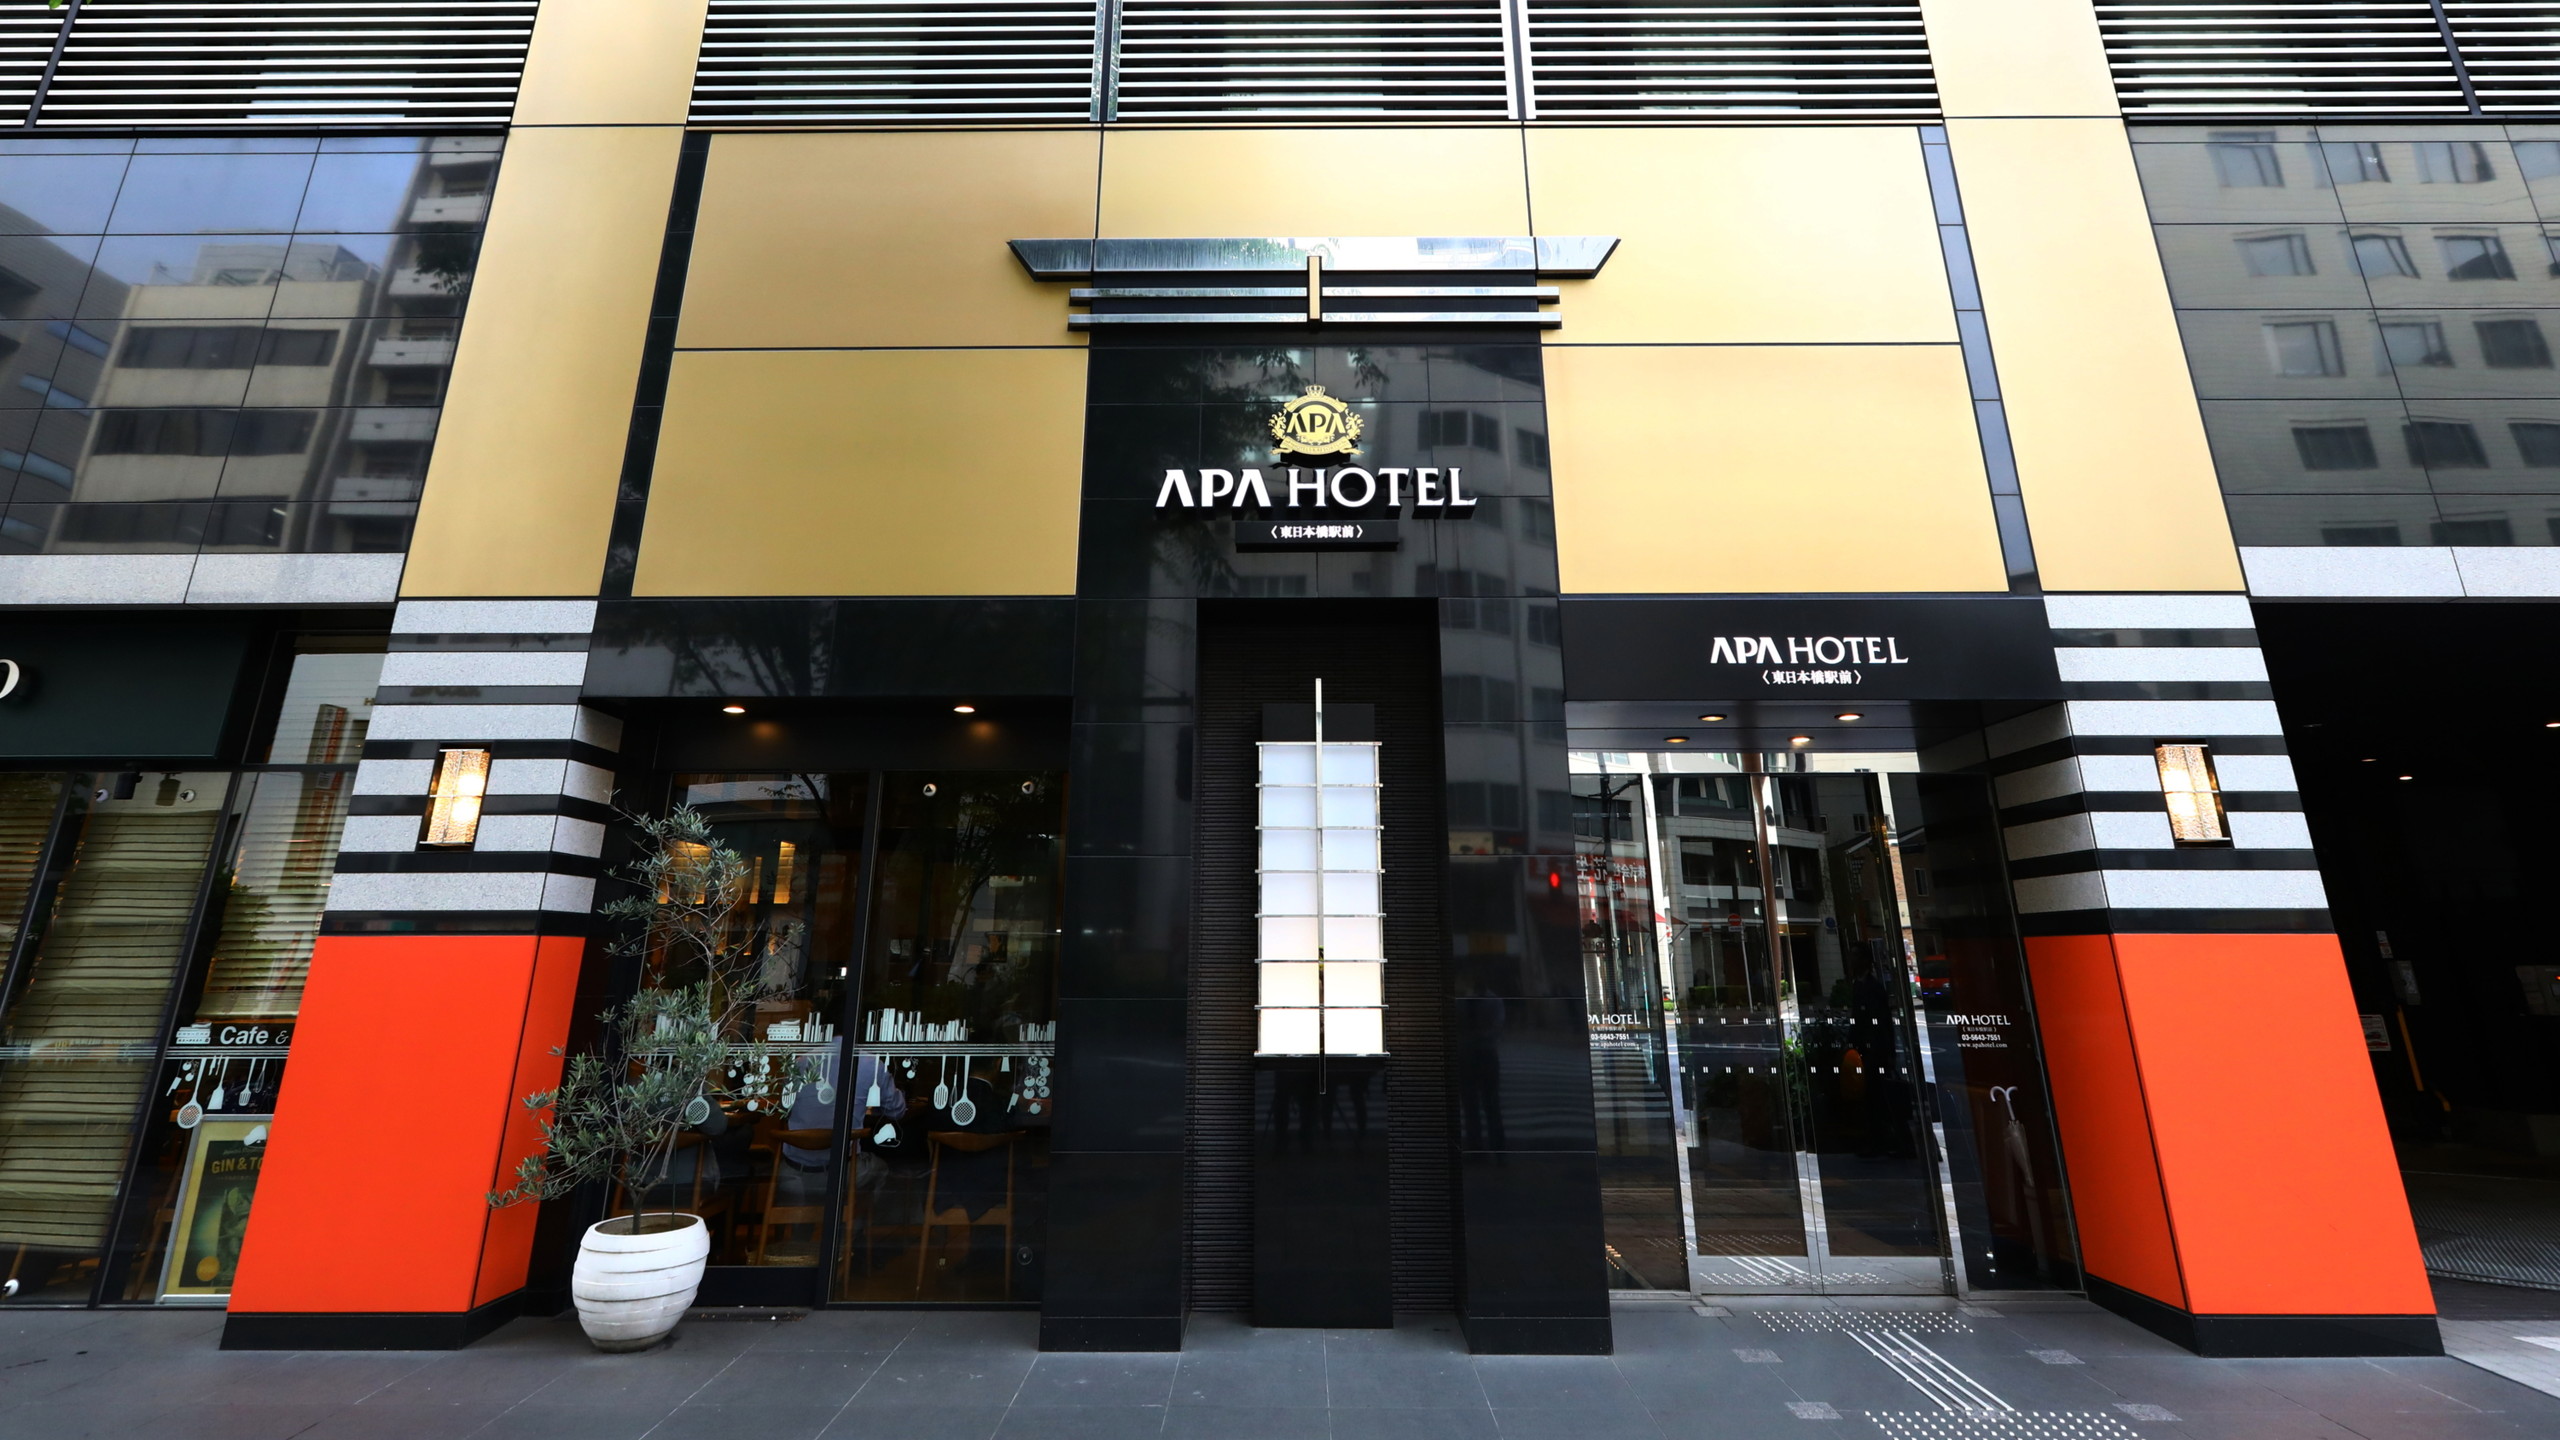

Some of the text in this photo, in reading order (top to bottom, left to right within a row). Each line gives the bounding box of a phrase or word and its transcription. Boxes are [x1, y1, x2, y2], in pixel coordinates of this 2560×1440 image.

[1286, 412, 1346, 433] APA
[1155, 467, 1478, 508] APA HOTEL
[1710, 636, 1909, 664] APA HOTEL
[1602, 1014, 1641, 1025] HOTEL
[1946, 1014, 2011, 1025] APA HOTEL
[220, 1026, 289, 1045] Cafe &
[211, 1158, 235, 1174] GIN
[237, 1157, 247, 1170] &
